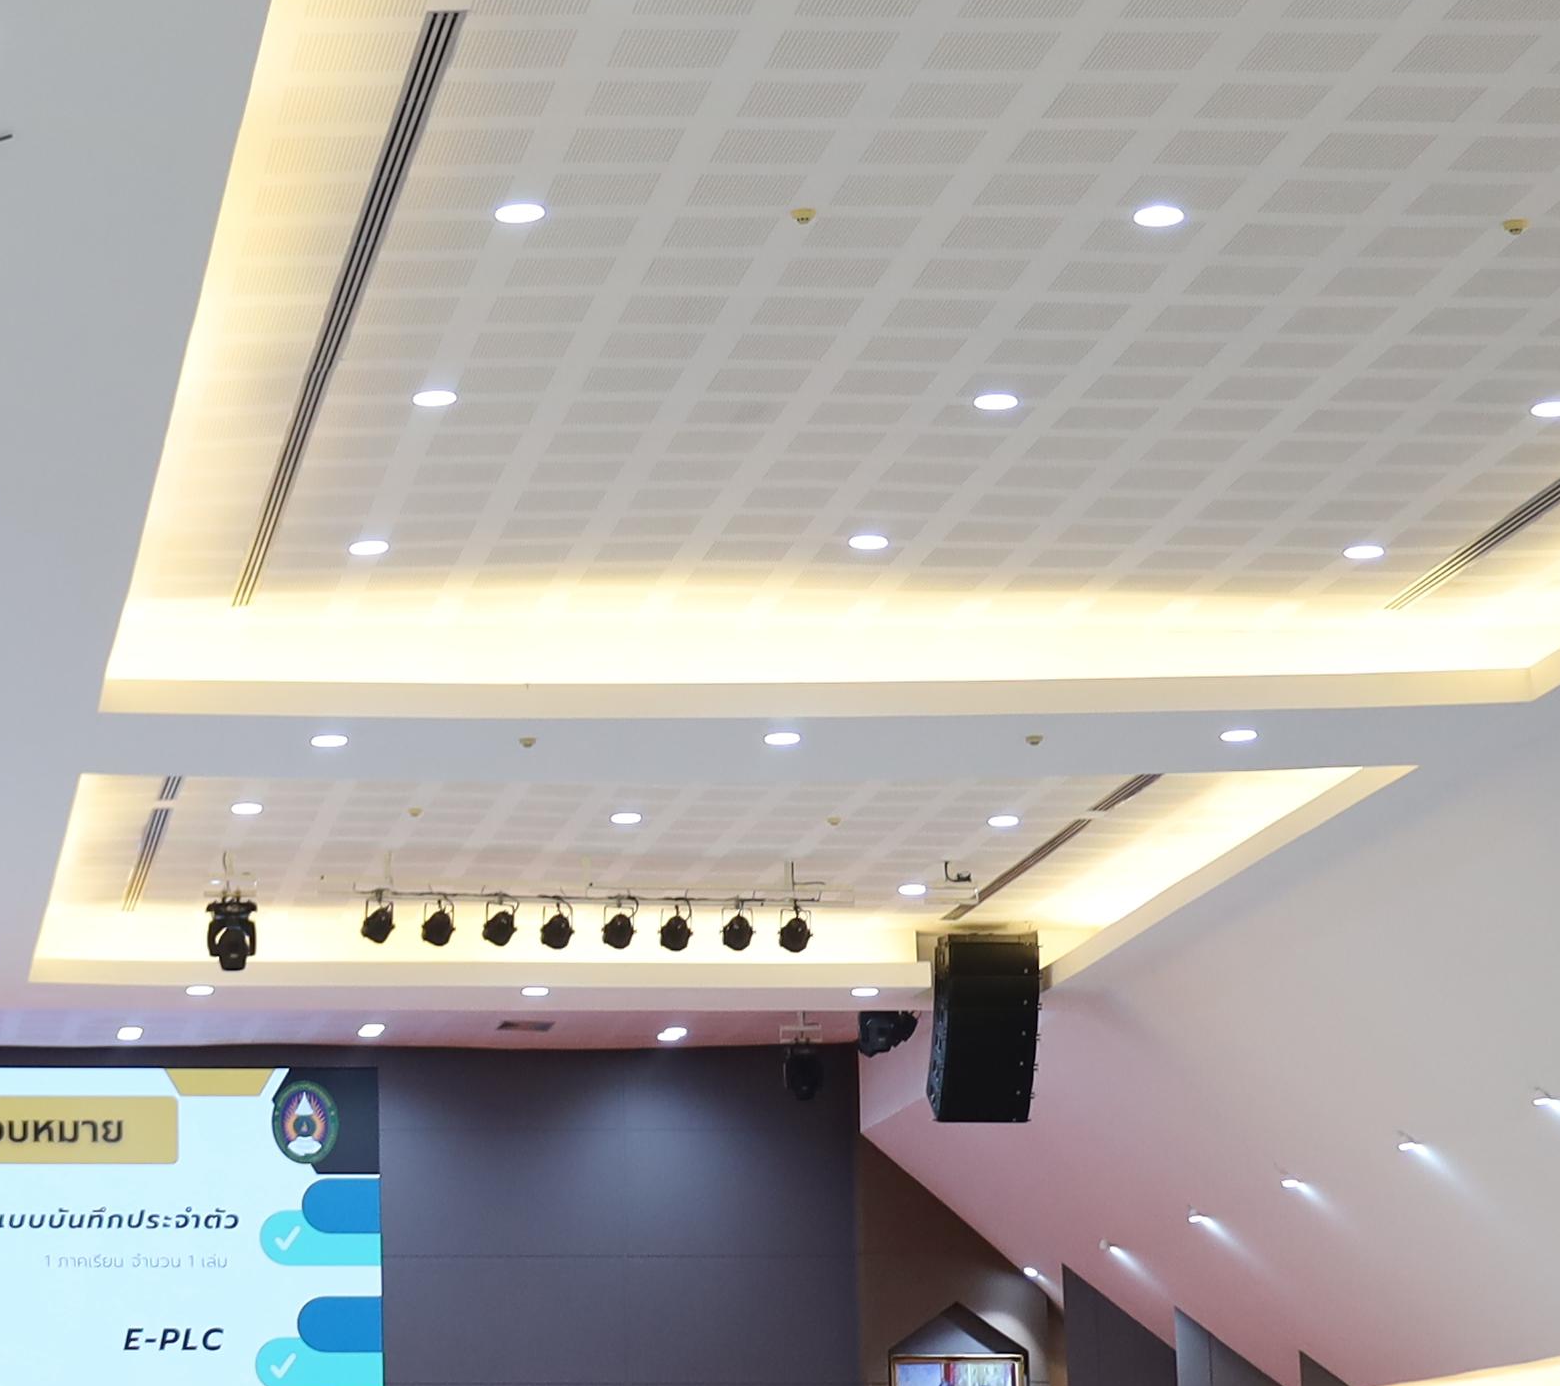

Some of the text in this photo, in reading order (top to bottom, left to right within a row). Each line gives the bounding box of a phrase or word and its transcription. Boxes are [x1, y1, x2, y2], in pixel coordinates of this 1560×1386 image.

[58, 1254, 124, 1269] ภาคเรียน
[132, 1253, 180, 1269] จำนวน
[201, 1253, 228, 1269] เล่ม
[123, 1327, 224, 1351] E-PLC
